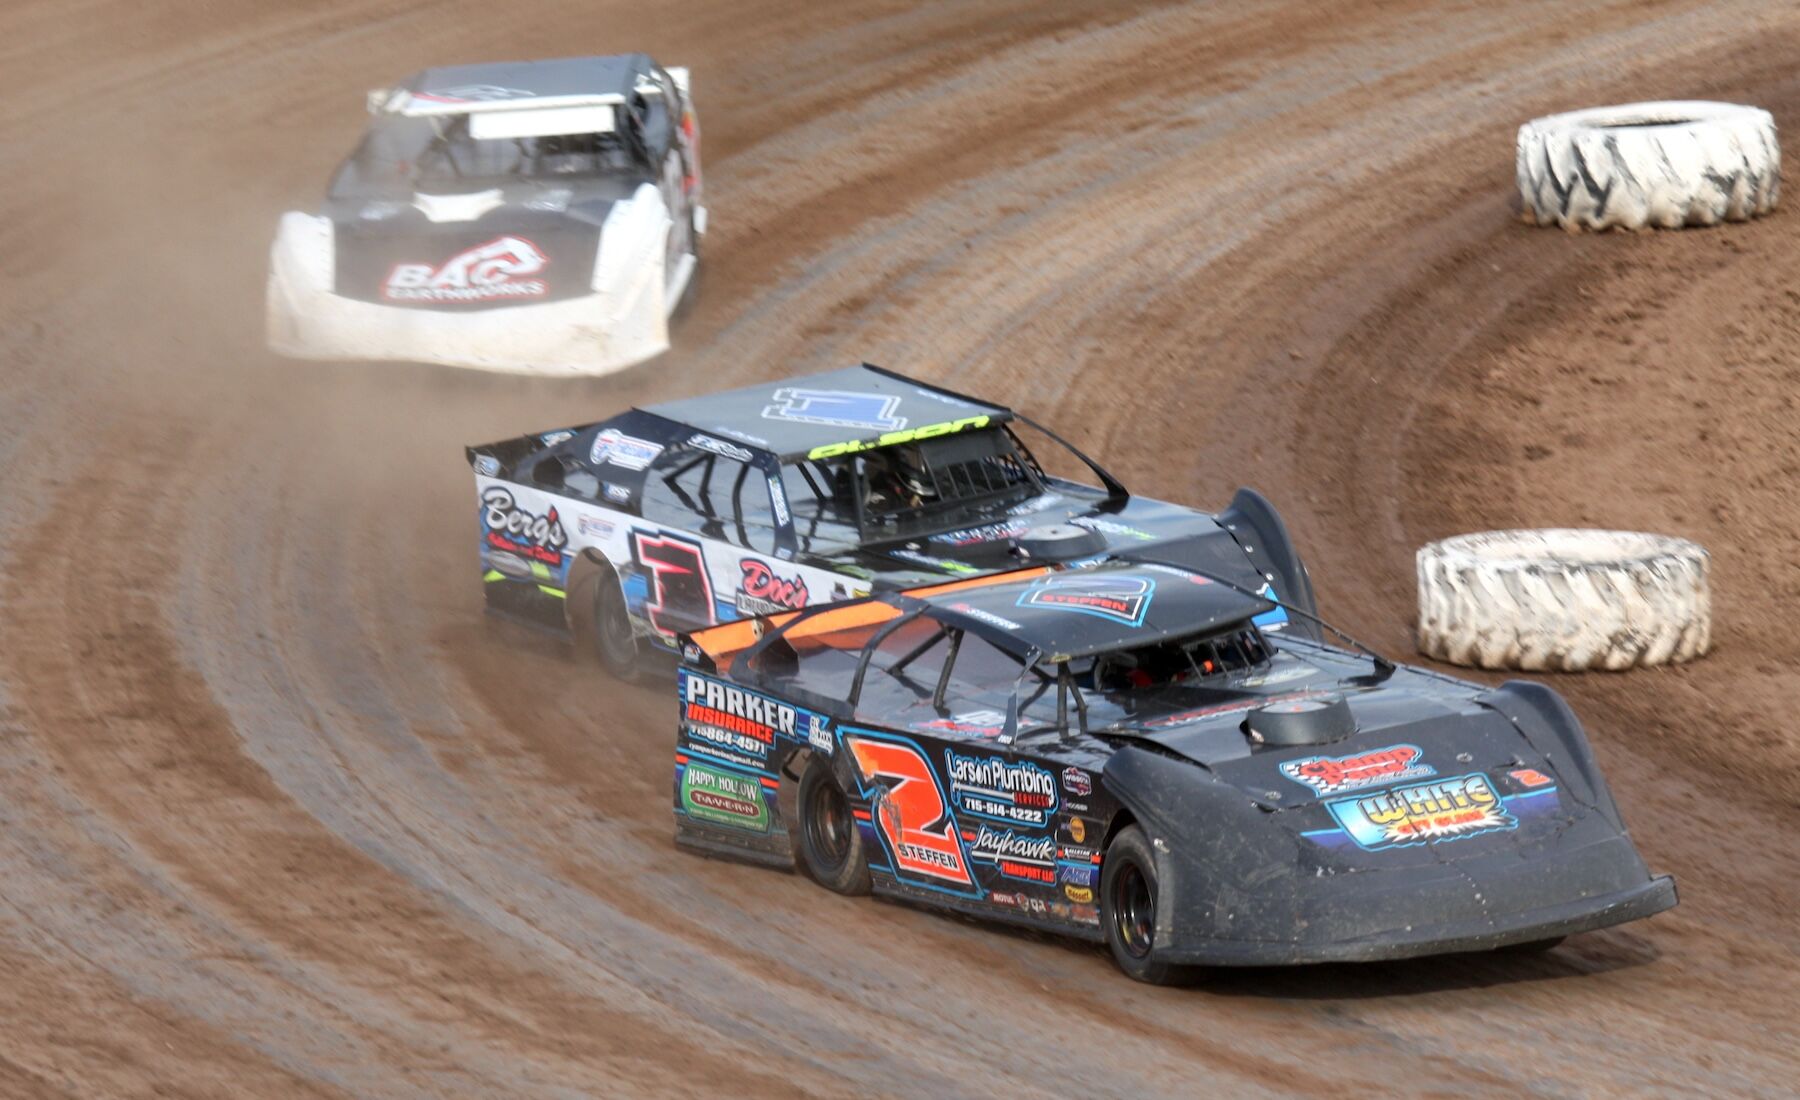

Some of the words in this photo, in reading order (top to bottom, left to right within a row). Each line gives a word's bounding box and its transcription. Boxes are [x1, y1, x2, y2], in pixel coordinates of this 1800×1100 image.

[1042, 594, 1128, 612] STEFFEN
[687, 675, 796, 737] PARKER
[687, 703, 774, 744] INSURANCE
[688, 768, 716, 788] HAPPY
[947, 753, 991, 785] Larson
[993, 760, 1054, 807] Plumbing
[1510, 769, 1553, 787] 2
[847, 737, 973, 886] 2
[965, 798, 1042, 822] 715-514-4222
[898, 843, 959, 869] STEFFEN
[972, 827, 1056, 863] Jayhawk
[1002, 862, 1041, 880] TRANSPORT
[1042, 869, 1055, 883] LLC
